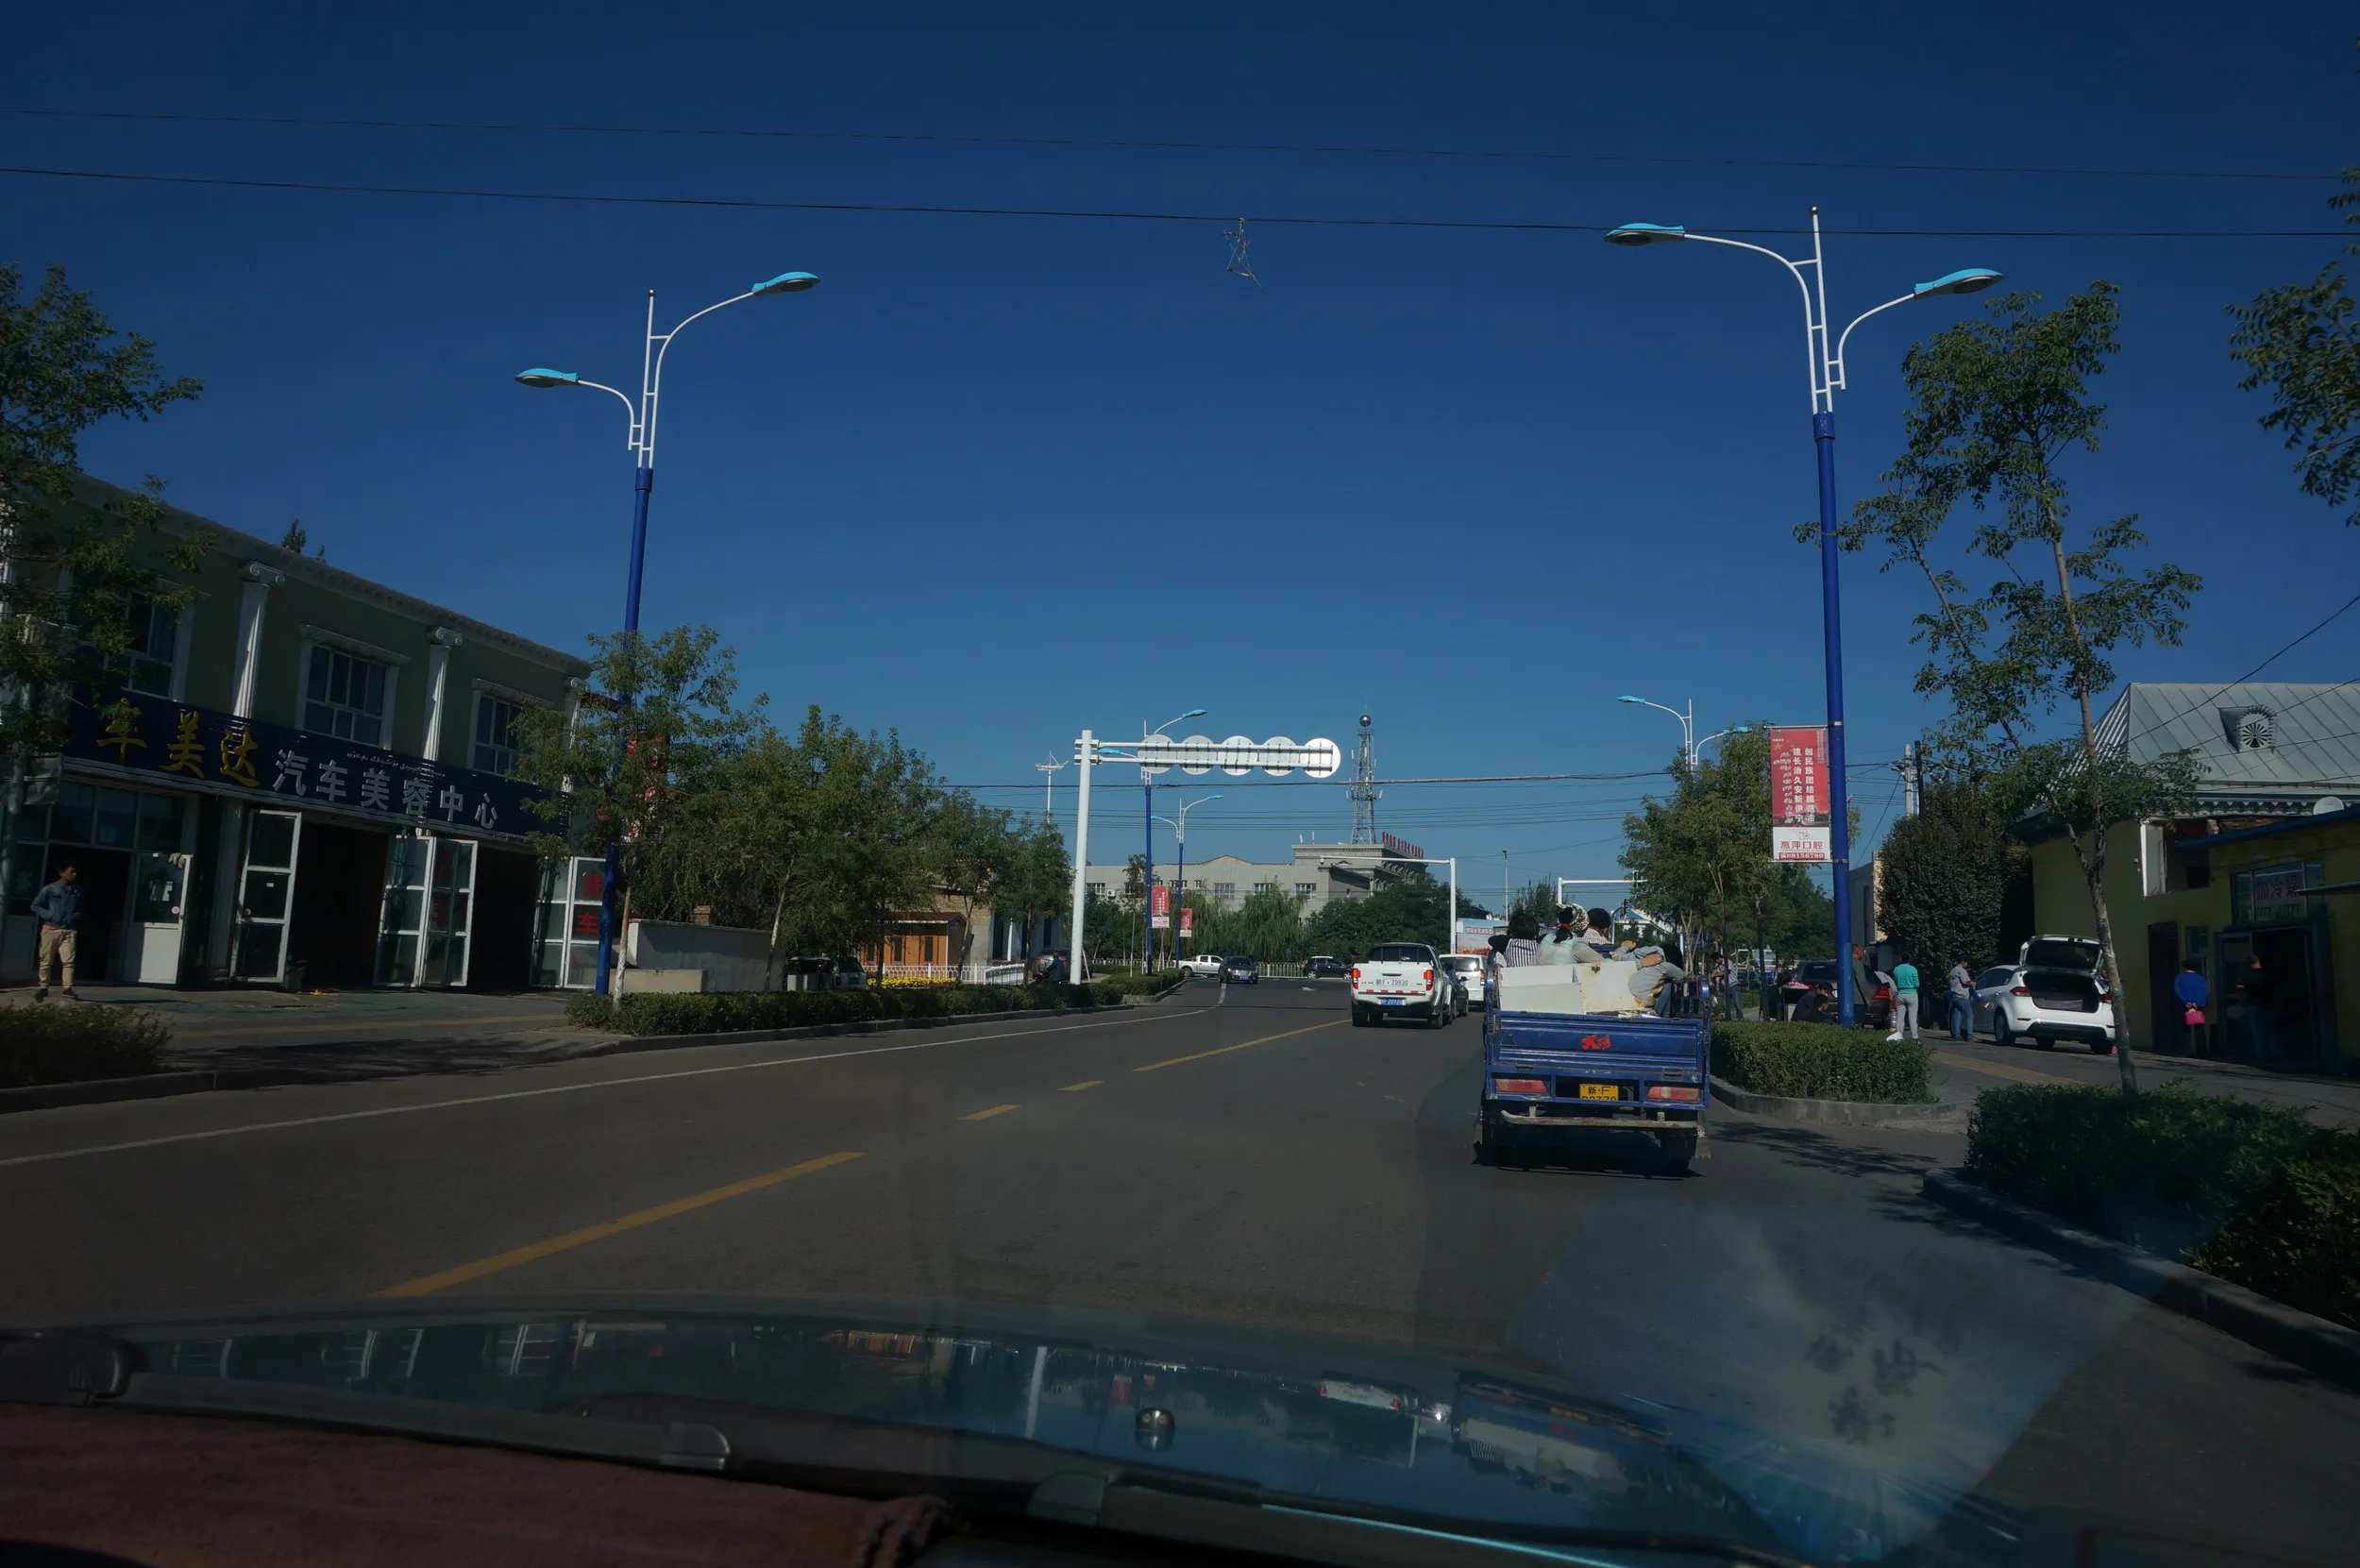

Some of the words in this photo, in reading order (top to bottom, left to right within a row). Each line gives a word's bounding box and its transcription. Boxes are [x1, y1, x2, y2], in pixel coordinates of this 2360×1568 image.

[272, 749, 499, 829] 汽车美容中心
[1793, 747, 1803, 823] 建长治久安新伊宁
[1804, 747, 1815, 822] 创民族团结模范市
